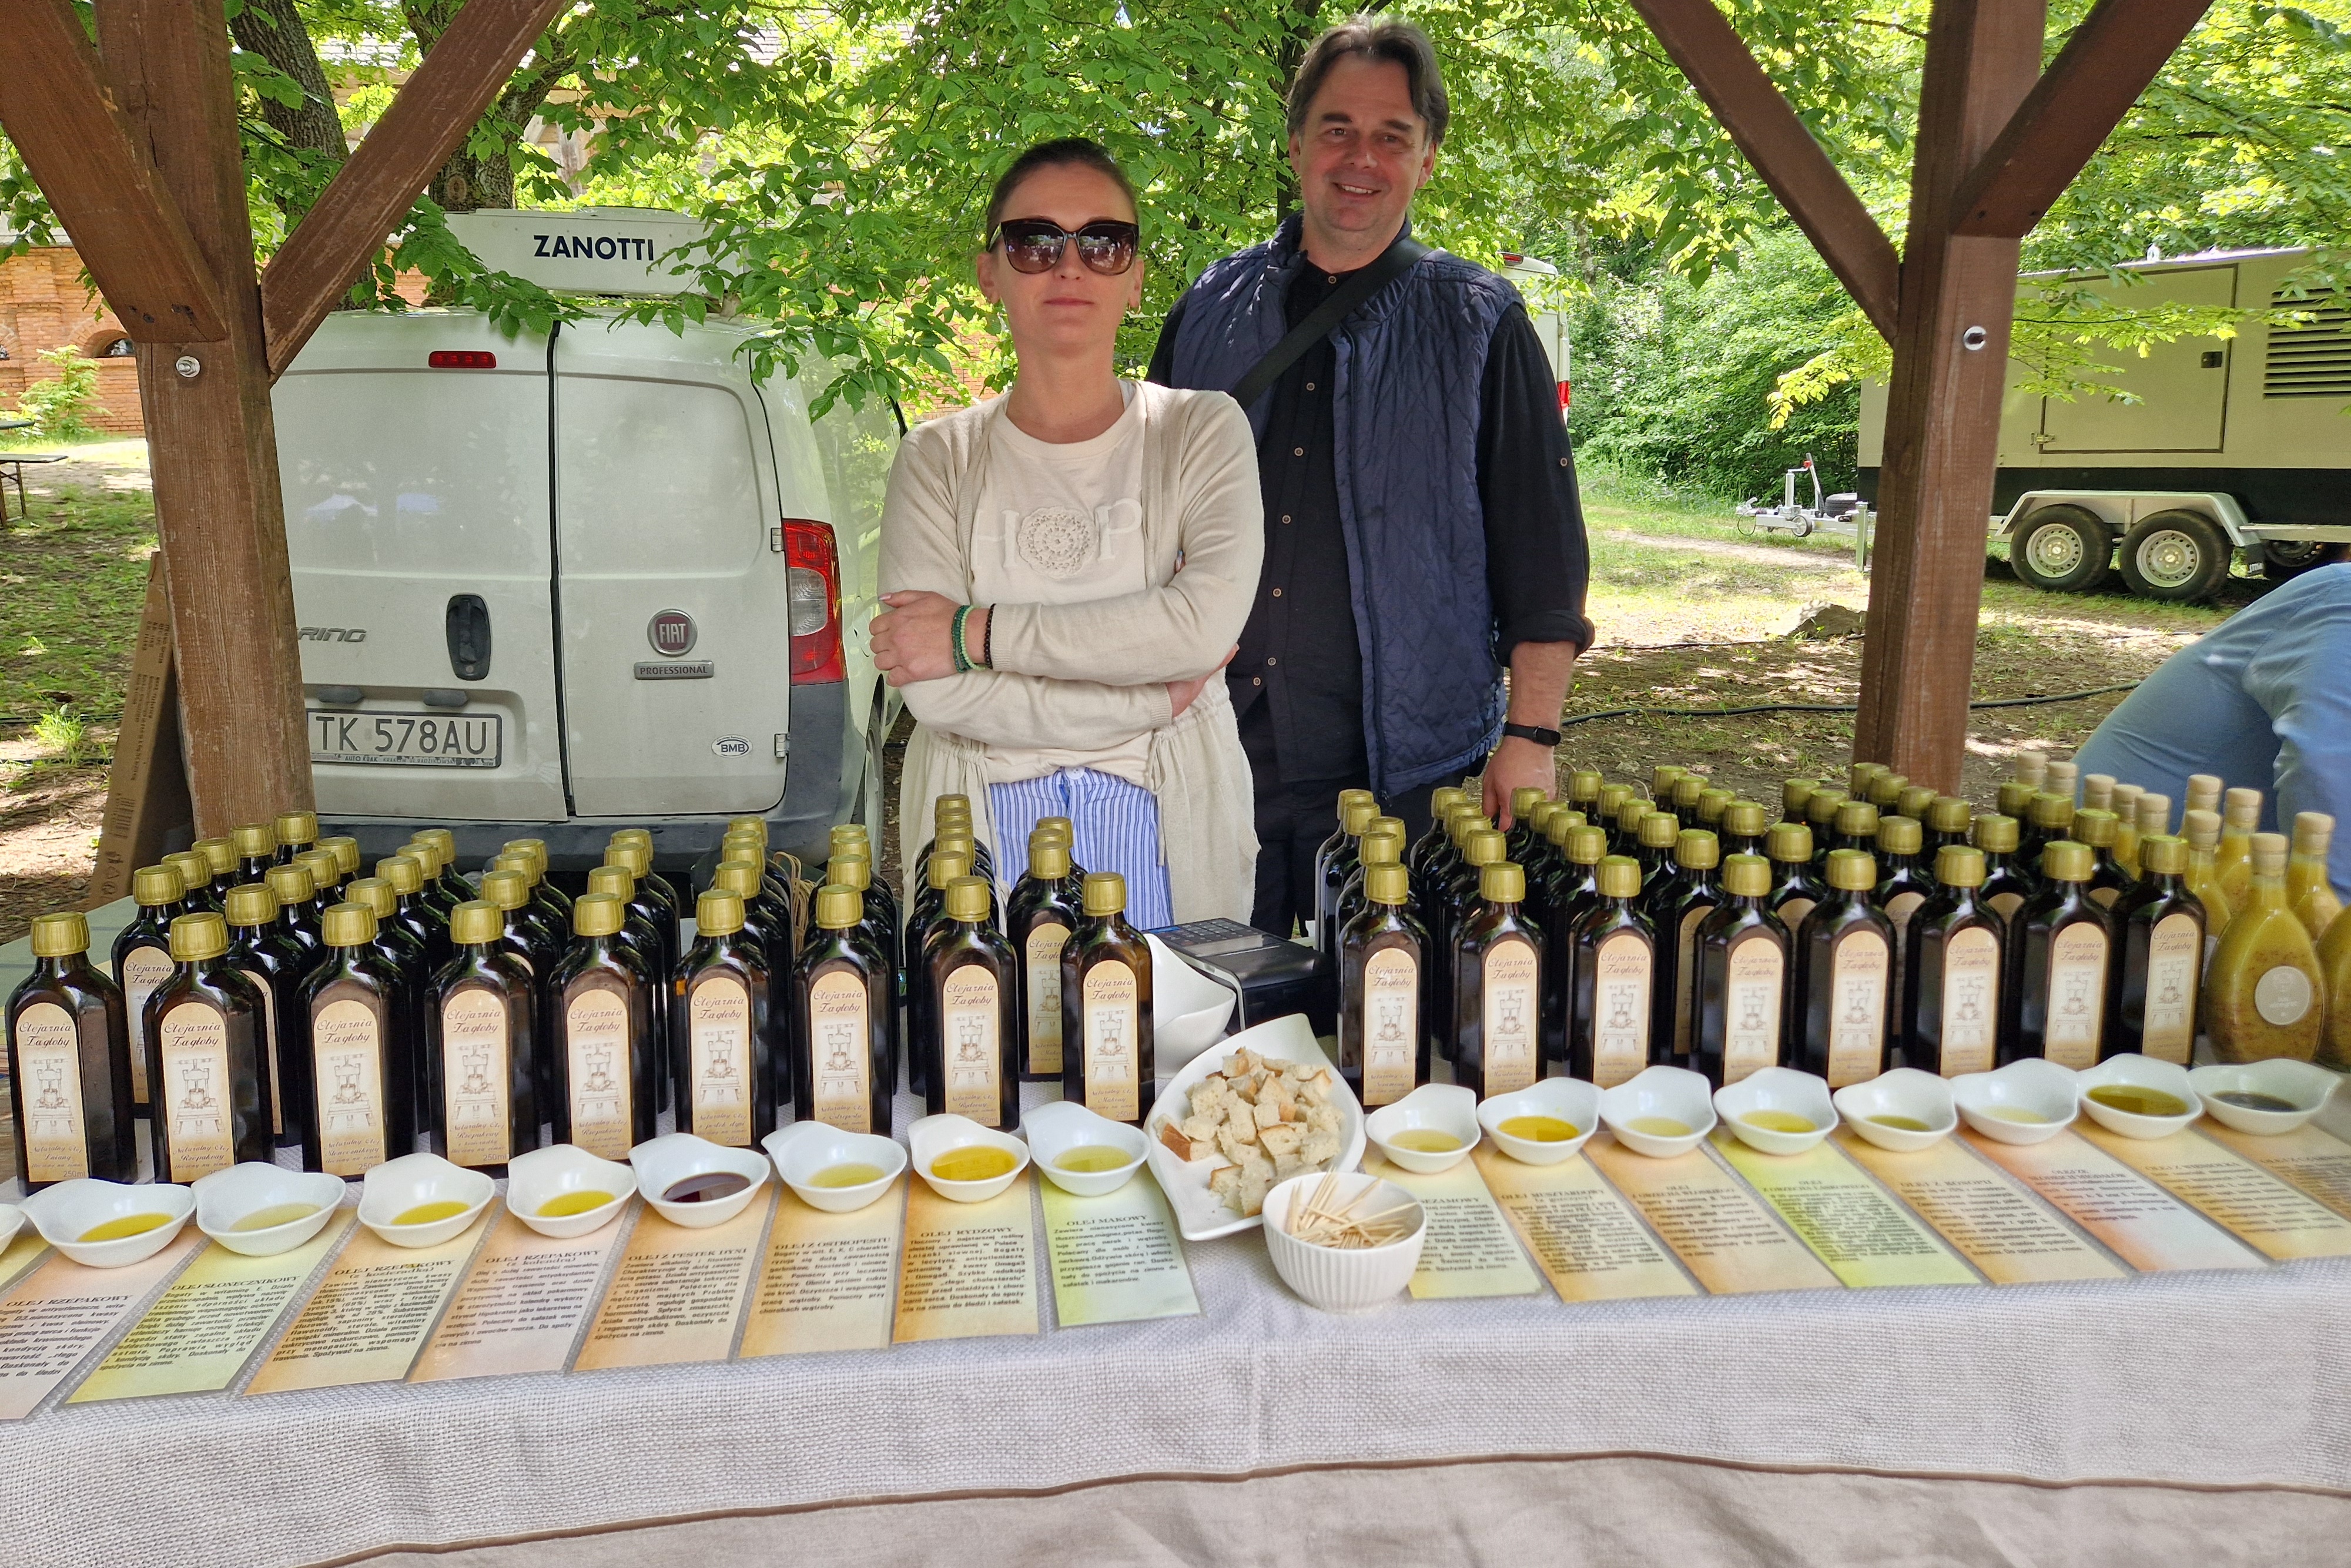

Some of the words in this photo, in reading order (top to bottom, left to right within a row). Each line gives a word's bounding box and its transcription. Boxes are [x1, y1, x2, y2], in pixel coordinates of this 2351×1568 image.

[534, 234, 654, 260] ZANOTTI
[659, 624, 686, 643] FIAT
[641, 666, 707, 675] PROFESSIONAL
[316, 716, 358, 751] TK
[374, 719, 487, 754] 578AU
[721, 744, 745, 752] BMB
[2154, 930, 2195, 941] Olejarnia
[1488, 957, 1533, 969] Olejarnia
[1601, 953, 1647, 963] Olejarnia
[126, 962, 172, 973] Olejarnia
[1369, 966, 1414, 977] Olejarnia
[947, 983, 994, 993] Olejarnia
[1087, 978, 1133, 989] Olejarnia
[813, 990, 862, 1000] Olejarnia
[694, 996, 744, 1007] Olejarnia
[447, 1010, 501, 1020] Olejarnia
[570, 1009, 622, 1020] Olejarnia
[19, 1022, 71, 1034] Olejarnia
[165, 1023, 220, 1035] Olejarnia
[317, 1019, 372, 1031] Olejarnia
[173, 1145, 211, 1155] Naturalny
[525, 1250, 601, 1260] RZEPAKOWY
[374, 1260, 455, 1271] RZEPAKOWY
[203, 1276, 301, 1289] SŁONECZNIKOWY
[48, 1295, 133, 1305] RZEPAKOWY
[368, 1336, 416, 1345] wspomaga
[313, 1348, 352, 1358] Spożywać
